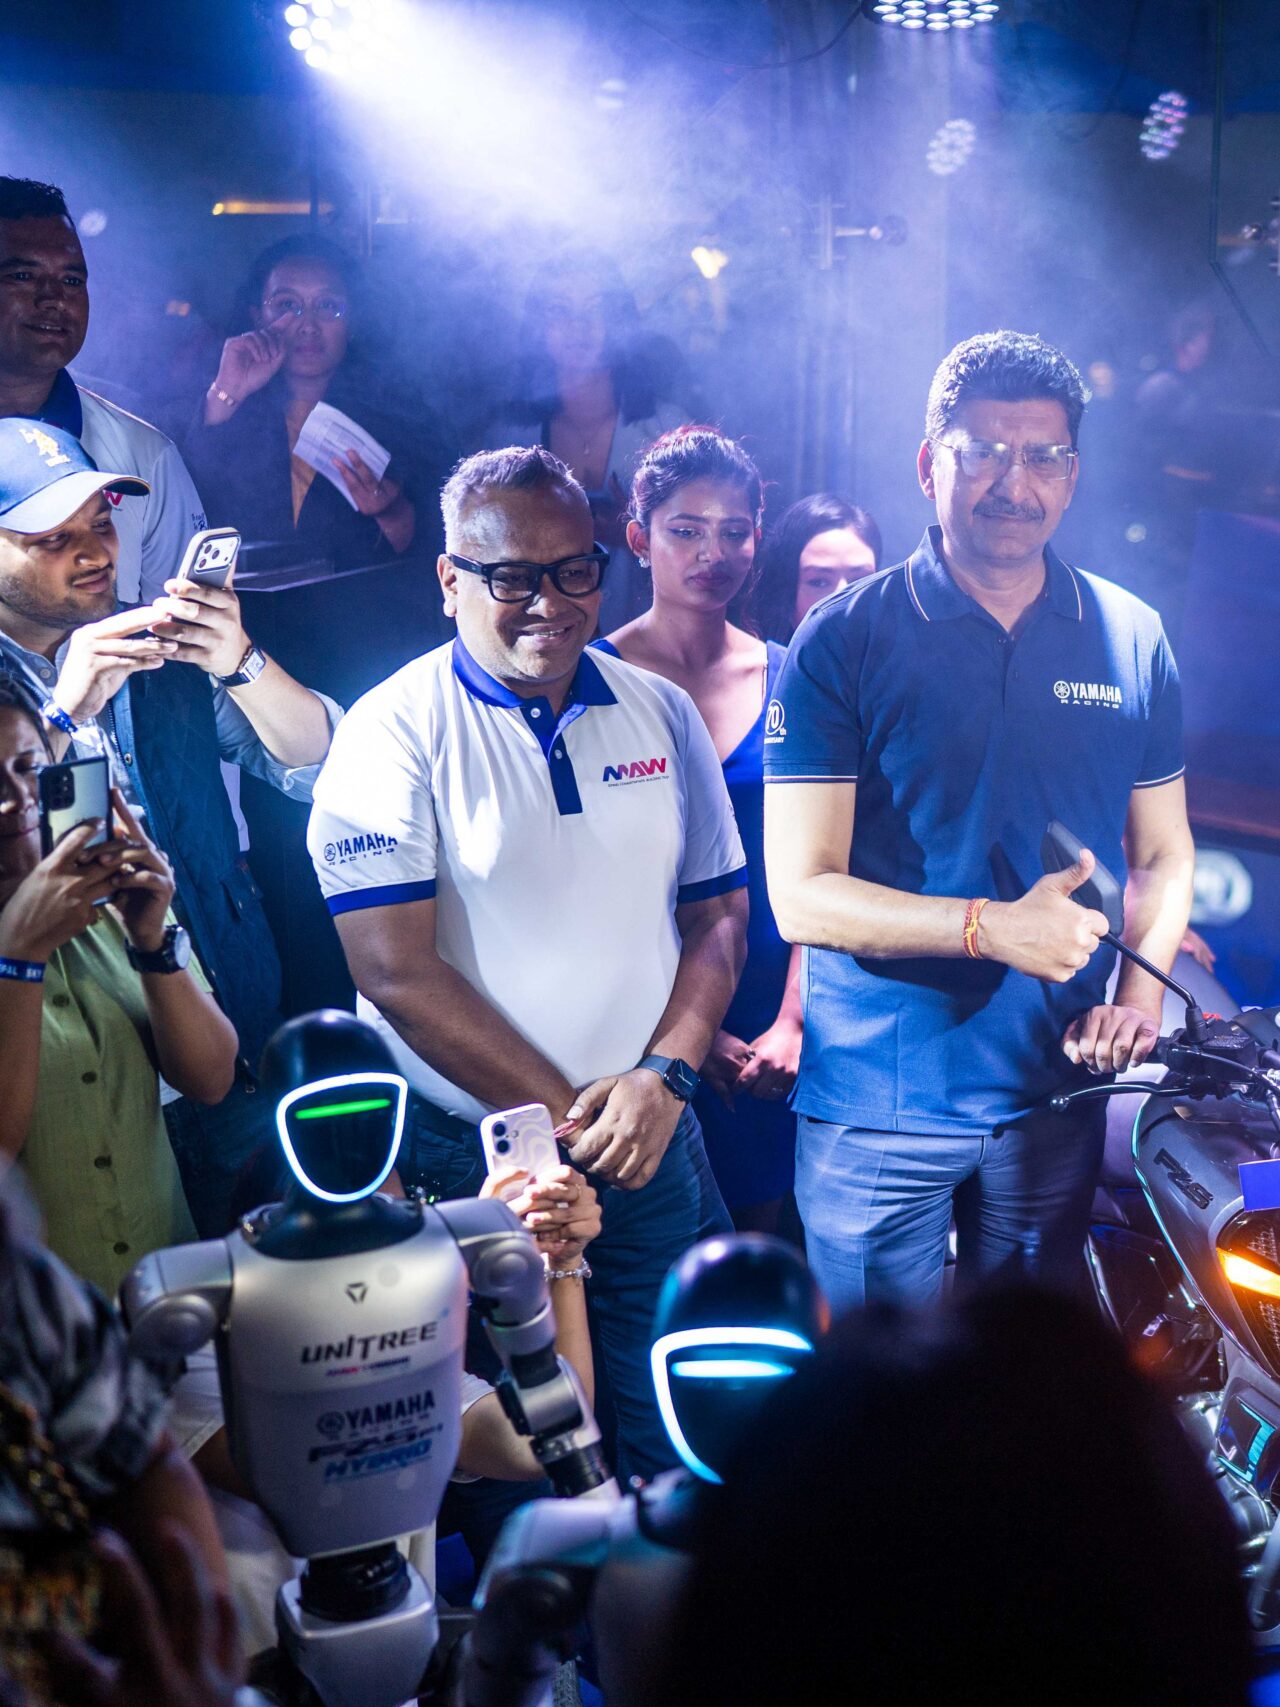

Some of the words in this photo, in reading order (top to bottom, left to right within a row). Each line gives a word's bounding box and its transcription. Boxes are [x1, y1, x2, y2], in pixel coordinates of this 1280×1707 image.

[1060, 699, 1119, 709] RACING
[1069, 682, 1122, 704] YAMAHA
[602, 757, 667, 782] MAW
[328, 847, 395, 866] RACING
[335, 832, 398, 857] YAMAHA
[301, 1321, 438, 1365] UNITREE
[345, 1389, 436, 1430] YAMAHA
